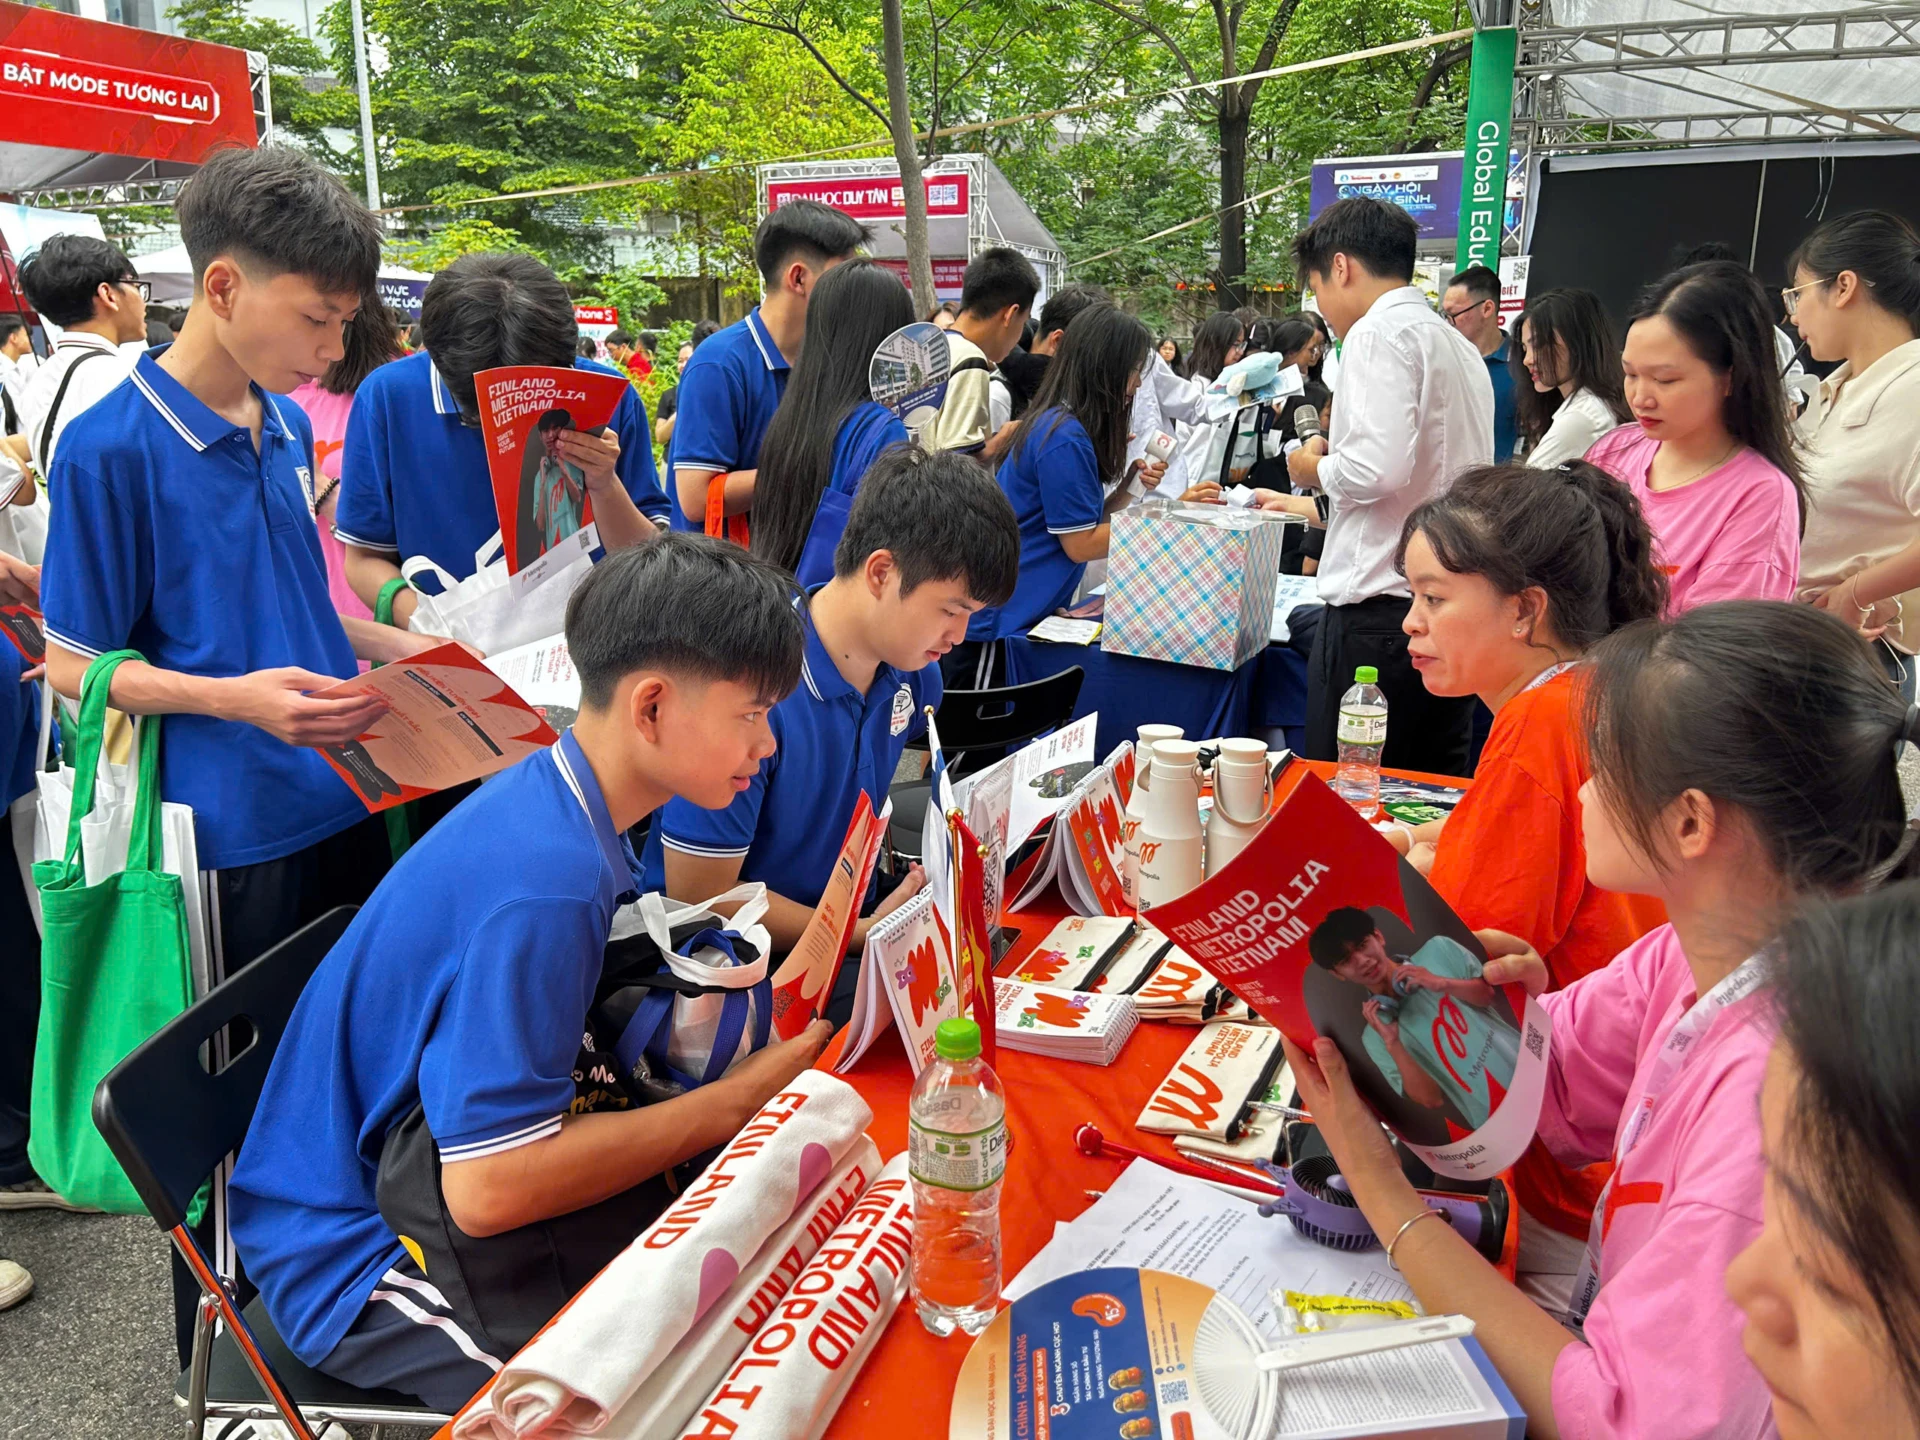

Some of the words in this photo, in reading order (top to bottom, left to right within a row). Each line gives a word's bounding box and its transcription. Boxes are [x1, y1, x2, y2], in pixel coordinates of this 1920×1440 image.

[3, 62, 45, 87] BẬT
[113, 81, 177, 106] TƯƠNG
[181, 93, 208, 112] LAI
[1473, 121, 1499, 202] Global
[843, 190, 864, 205] DUY
[865, 188, 888, 204] TÂN
[1350, 182, 1393, 195] NGÀY
[1395, 181, 1421, 194] HỘI
[1395, 194, 1430, 204] SINH
[488, 378, 556, 399] FINLAND
[490, 389, 587, 414] METROPOLIA
[492, 399, 554, 428] VIETNAM
[1171, 889, 1260, 943] FINLAND
[1190, 859, 1330, 959] METROPOLIA
[1208, 915, 1311, 975] VIETNAM
[1204, 1025, 1232, 1056] VIETNAM
[1207, 1027, 1242, 1068] METROPOLIA
[1227, 1029, 1253, 1059] FINLAND
[1434, 1143, 1486, 1162] Metropolia
[643, 1092, 809, 1249] FINLAND
[681, 1179, 907, 1440] METROPOLIA
[1016, 1334, 1026, 1361] HÀNG
[1015, 1363, 1027, 1393] NGÂN
[1013, 1400, 1028, 1436] CHÍNH
